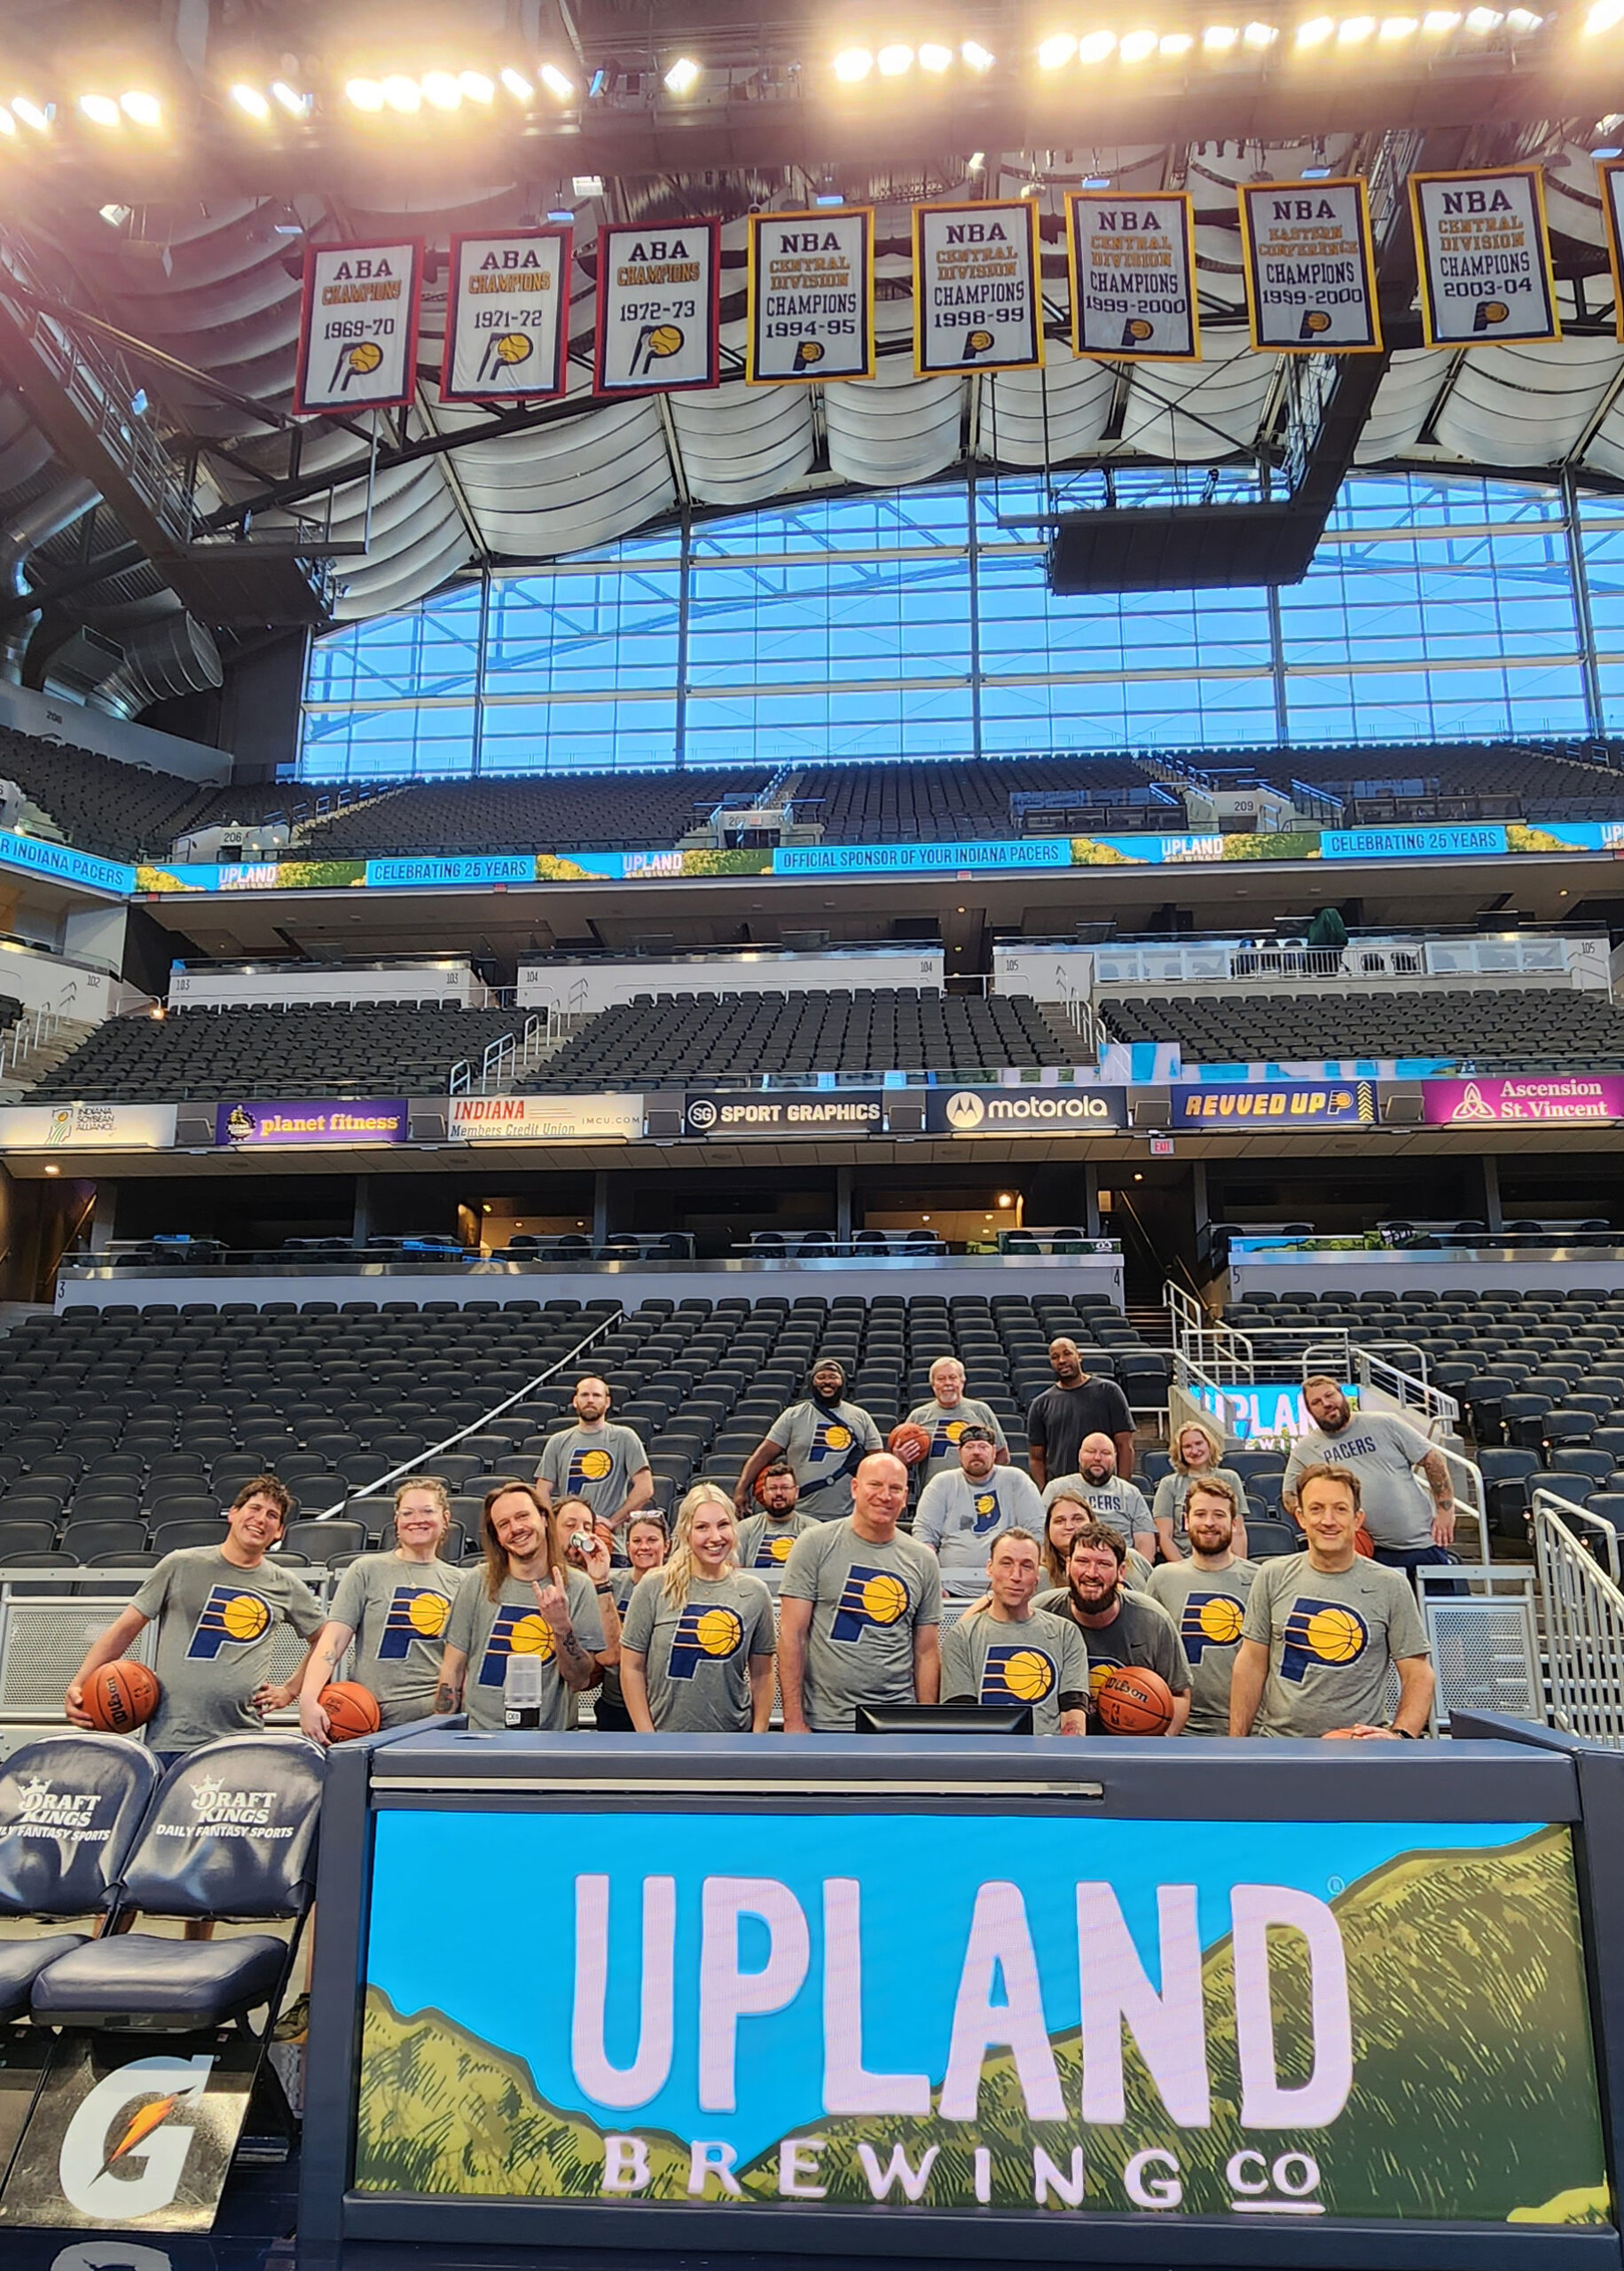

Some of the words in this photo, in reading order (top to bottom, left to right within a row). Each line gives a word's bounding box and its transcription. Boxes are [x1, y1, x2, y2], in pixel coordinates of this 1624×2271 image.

[1273, 200, 1336, 220] NBA
[1442, 189, 1512, 215] NBA
[1098, 211, 1161, 231] NBA
[1438, 216, 1524, 234] CENTRAL
[781, 232, 841, 254] NBA
[945, 223, 1007, 245] NBA
[1269, 225, 1342, 242] EASTERN
[1440, 232, 1525, 251] DIVISION
[628, 240, 689, 262] ABA
[1090, 236, 1172, 251] CENTRAL
[1259, 241, 1358, 257] CONFERENCE
[480, 249, 541, 270] ABA
[936, 246, 1018, 264] CENTRAL
[1091, 251, 1172, 267] DIVISION
[1440, 252, 1529, 277] CHAMPIONS
[333, 259, 392, 280] ABA
[616, 262, 700, 286] CHAMPIONS
[769, 256, 851, 274] CENTRAL
[937, 263, 1016, 281] DIVISION
[1266, 262, 1354, 284] CHAMPIONS
[468, 271, 551, 294] CHAMPIONS
[770, 273, 849, 291] DIVISION
[1090, 271, 1178, 295] CHAMPIONS
[1444, 277, 1532, 297] 2003-04
[322, 279, 402, 305] CHAMPIONS
[934, 280, 1024, 307] CHAMPIONS
[1262, 287, 1362, 304] 1999-2000
[620, 300, 695, 322] 1972-73
[766, 293, 857, 318] CHAMPIONS
[1085, 295, 1186, 314] 1999-2000
[475, 310, 543, 329] 1971-72
[934, 306, 1024, 328] 1998-99
[324, 318, 395, 340] 1969-70
[765, 319, 856, 338] 1994-95
[1234, 800, 1253, 812] 209
[224, 832, 242, 843] 206
[1162, 837, 1223, 855] UPLAND
[1331, 832, 1425, 853] CELEBRATING
[1429, 832, 1447, 849] 25
[1449, 830, 1496, 849] YEARS
[13, 842, 69, 870] INDIANA
[73, 859, 124, 885] PACERS
[623, 853, 682, 872] UPLAND
[784, 851, 839, 868] OFFICIAL
[841, 849, 897, 866] SPONSOR
[899, 849, 916, 865] OF
[919, 848, 953, 864] YOUR
[955, 847, 1007, 863] INDIANA
[1009, 845, 1059, 861] PACERS
[219, 865, 277, 883] UPLAND
[374, 861, 461, 880] CELEBRATING
[465, 861, 481, 877] 25
[484, 860, 527, 876] YEARS
[1581, 941, 1596, 954] 105
[921, 962, 932, 972] 104
[1006, 960, 1019, 970] 105
[87, 975, 100, 987] 102
[176, 979, 190, 990] 103
[447, 972, 459, 984] 103
[527, 971, 538, 982] 104
[1500, 1079, 1603, 1097] Ascension
[454, 1100, 525, 1120] INDIANA
[692, 1106, 712, 1120] SG
[721, 1104, 780, 1122] SPORT
[787, 1103, 881, 1121] GRAPHICS
[988, 1096, 1108, 1119] motorola
[1185, 1094, 1288, 1116] REVVED
[1291, 1092, 1326, 1113] UP
[1500, 1101, 1527, 1118] St.
[1529, 1099, 1608, 1117] Vincent
[76, 1115, 114, 1124] SOYBEAN
[261, 1114, 325, 1136] planet
[329, 1113, 397, 1131] fitness
[450, 1124, 502, 1137] Members
[506, 1123, 540, 1136] Credit
[543, 1122, 576, 1136] Union
[1114, 1269, 1120, 1287] 4
[1233, 1269, 1241, 1285] 5
[58, 1280, 65, 1299] 3
[1324, 1436, 1376, 1464] PACERS
[1088, 1495, 1121, 1510] CERS
[1105, 1677, 1149, 1703] Wilson
[106, 1676, 129, 1725] Wilson
[18, 1793, 102, 1811] DRAFT
[191, 1791, 277, 1811] DRAFT
[16, 1811, 92, 1827] KINGS
[197, 1808, 270, 1825] KINGS
[18, 1827, 72, 1840] FANTASY
[71, 1829, 111, 1843] SPORTS
[156, 1824, 195, 1837] DAILY
[195, 1826, 250, 1838] FANTASY
[249, 1827, 294, 1839] SPORTS
[570, 1873, 1354, 2130] UPLAND
[602, 2134, 1181, 2211] BREWING
[1229, 2149, 1321, 2195] CO
